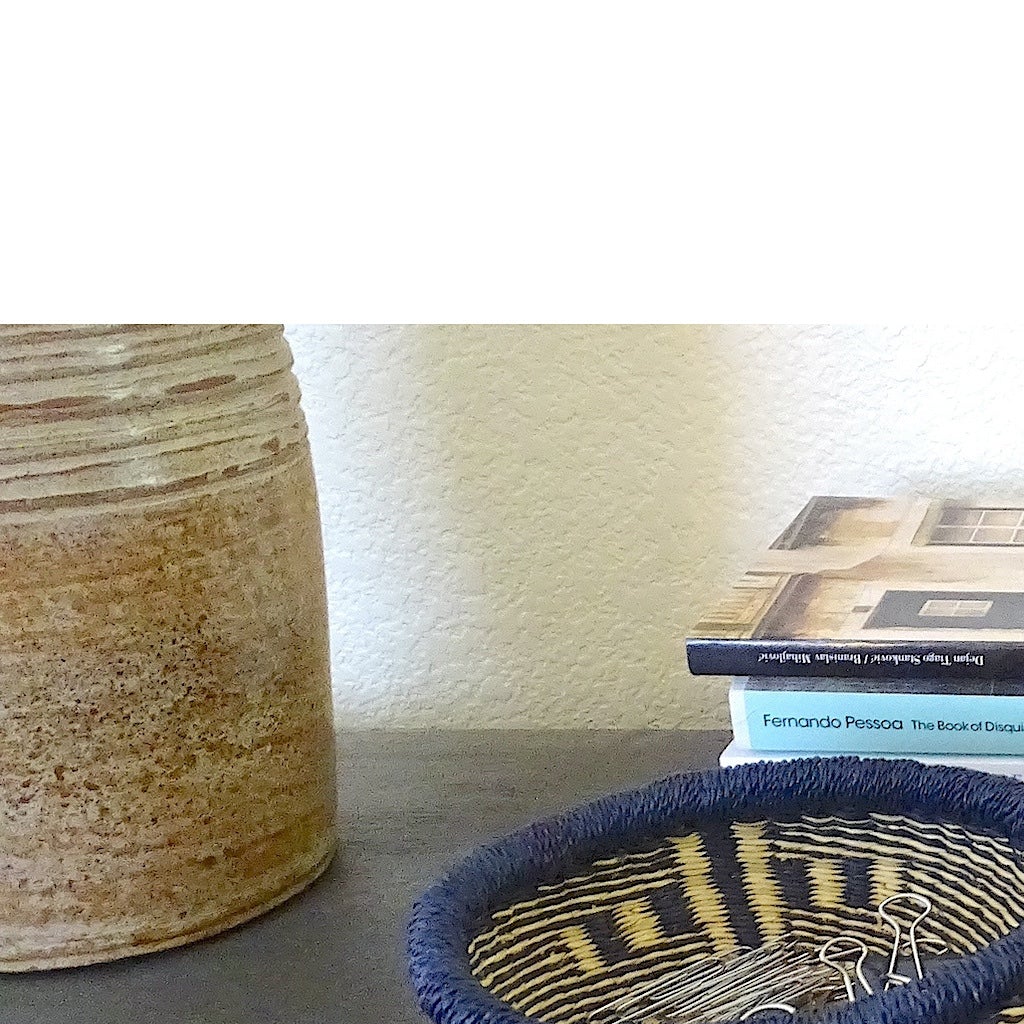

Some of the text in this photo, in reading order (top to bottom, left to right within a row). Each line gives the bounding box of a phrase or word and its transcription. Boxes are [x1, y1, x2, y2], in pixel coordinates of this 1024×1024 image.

[815, 653, 861, 665] Branislav
[922, 652, 953, 665] Tiago
[954, 653, 984, 666] Dejan
[763, 714, 842, 729] Fernando
[845, 716, 903, 730] Pessoa
[911, 719, 935, 731] The
[938, 720, 968, 732] Book
[969, 721, 982, 732] of
